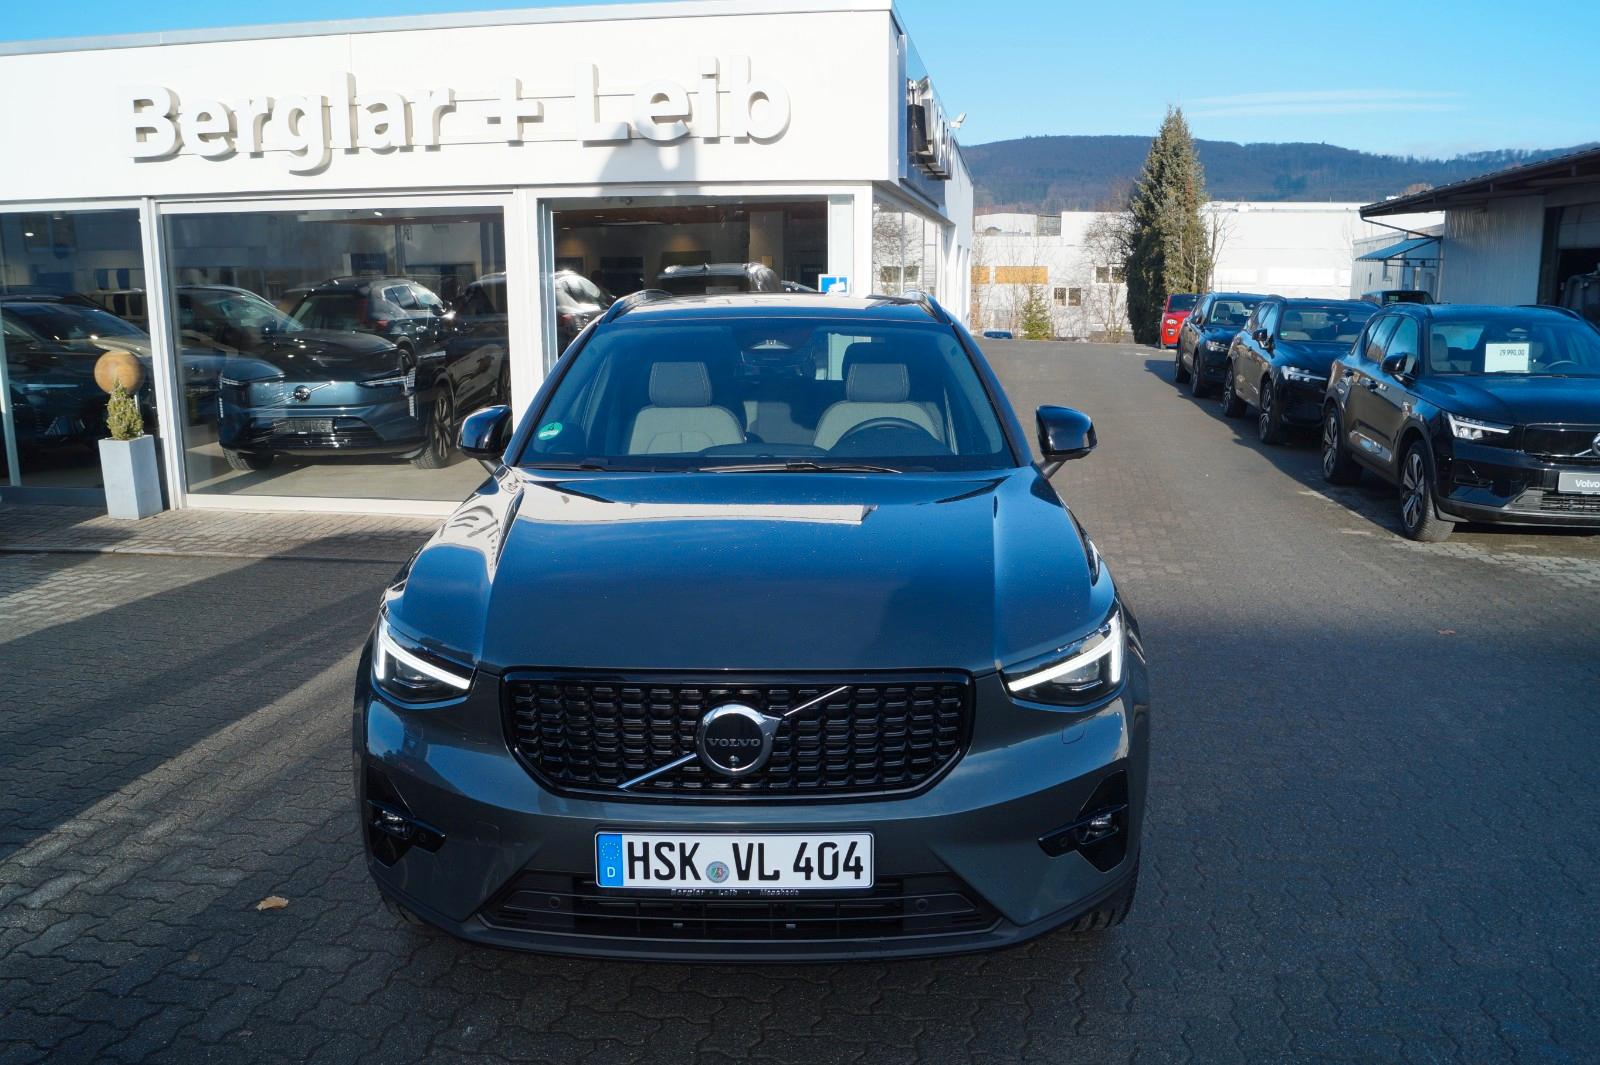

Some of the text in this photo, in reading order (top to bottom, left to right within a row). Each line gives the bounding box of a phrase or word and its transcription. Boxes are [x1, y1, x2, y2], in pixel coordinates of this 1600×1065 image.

[128, 71, 457, 176] Berglar
[574, 54, 792, 148] Leib
[706, 737, 761, 747] VOLVO
[606, 866, 616, 878] D
[627, 840, 864, 882] HSK VL 404
